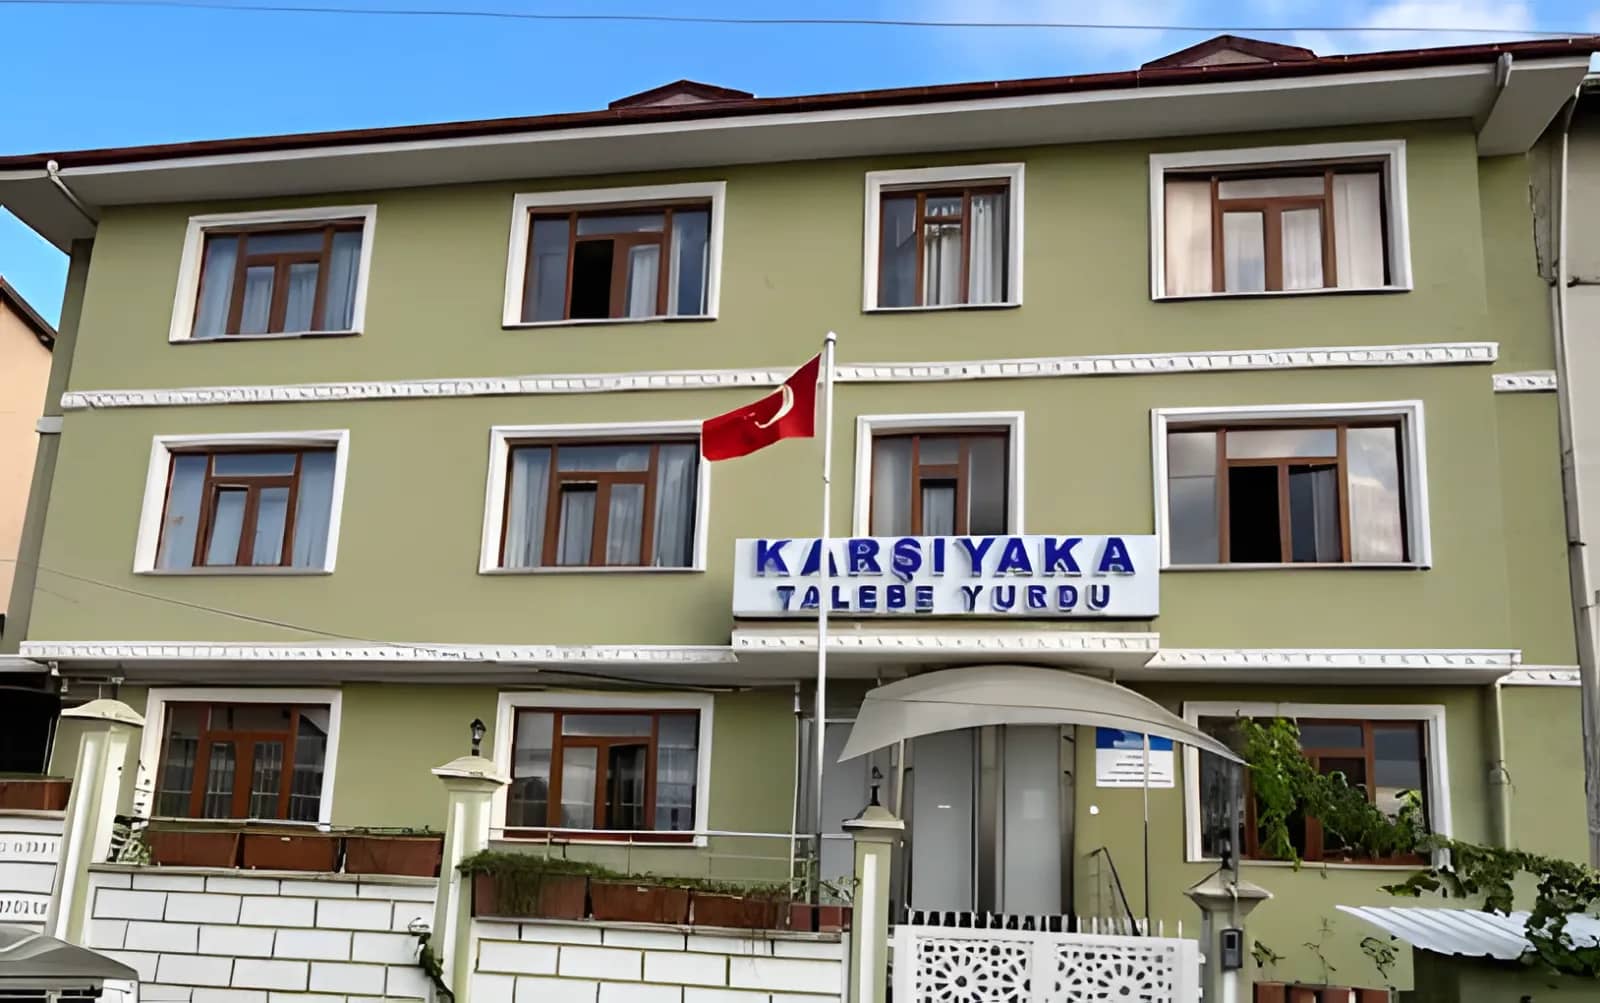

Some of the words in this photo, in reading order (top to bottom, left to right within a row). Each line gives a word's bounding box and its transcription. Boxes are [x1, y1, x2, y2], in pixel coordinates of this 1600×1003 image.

[756, 537, 1136, 583] KARŞIYAKA
[777, 585, 934, 612] TALEBE
[961, 585, 1111, 612] YURDU
